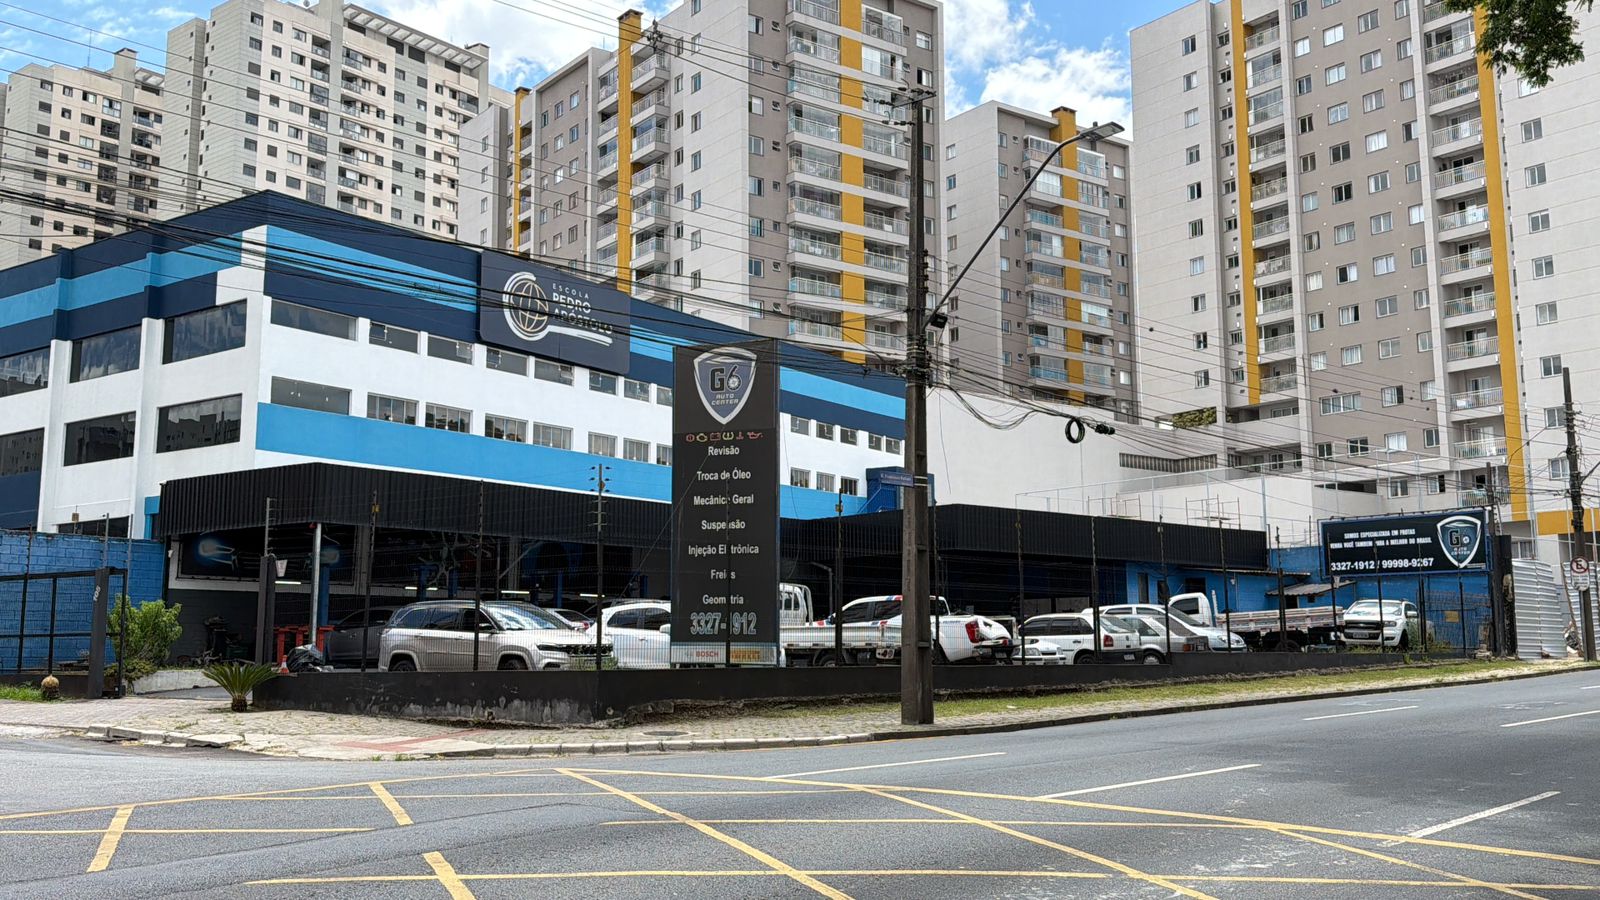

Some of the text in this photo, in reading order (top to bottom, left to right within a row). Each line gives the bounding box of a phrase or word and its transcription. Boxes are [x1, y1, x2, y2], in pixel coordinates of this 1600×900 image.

[553, 283, 589, 299] ESCOLA
[553, 292, 591, 313] PEDRO
[709, 364, 742, 393] G6
[708, 446, 740, 456] Revisão
[697, 467, 752, 481] Troca de Óleo
[732, 494, 754, 504] Geral
[688, 543, 760, 557] Injeção Eltrônica
[1330, 561, 1375, 571] 3327-1912
[710, 569, 736, 580] Freis
[702, 594, 744, 605] Geomtria
